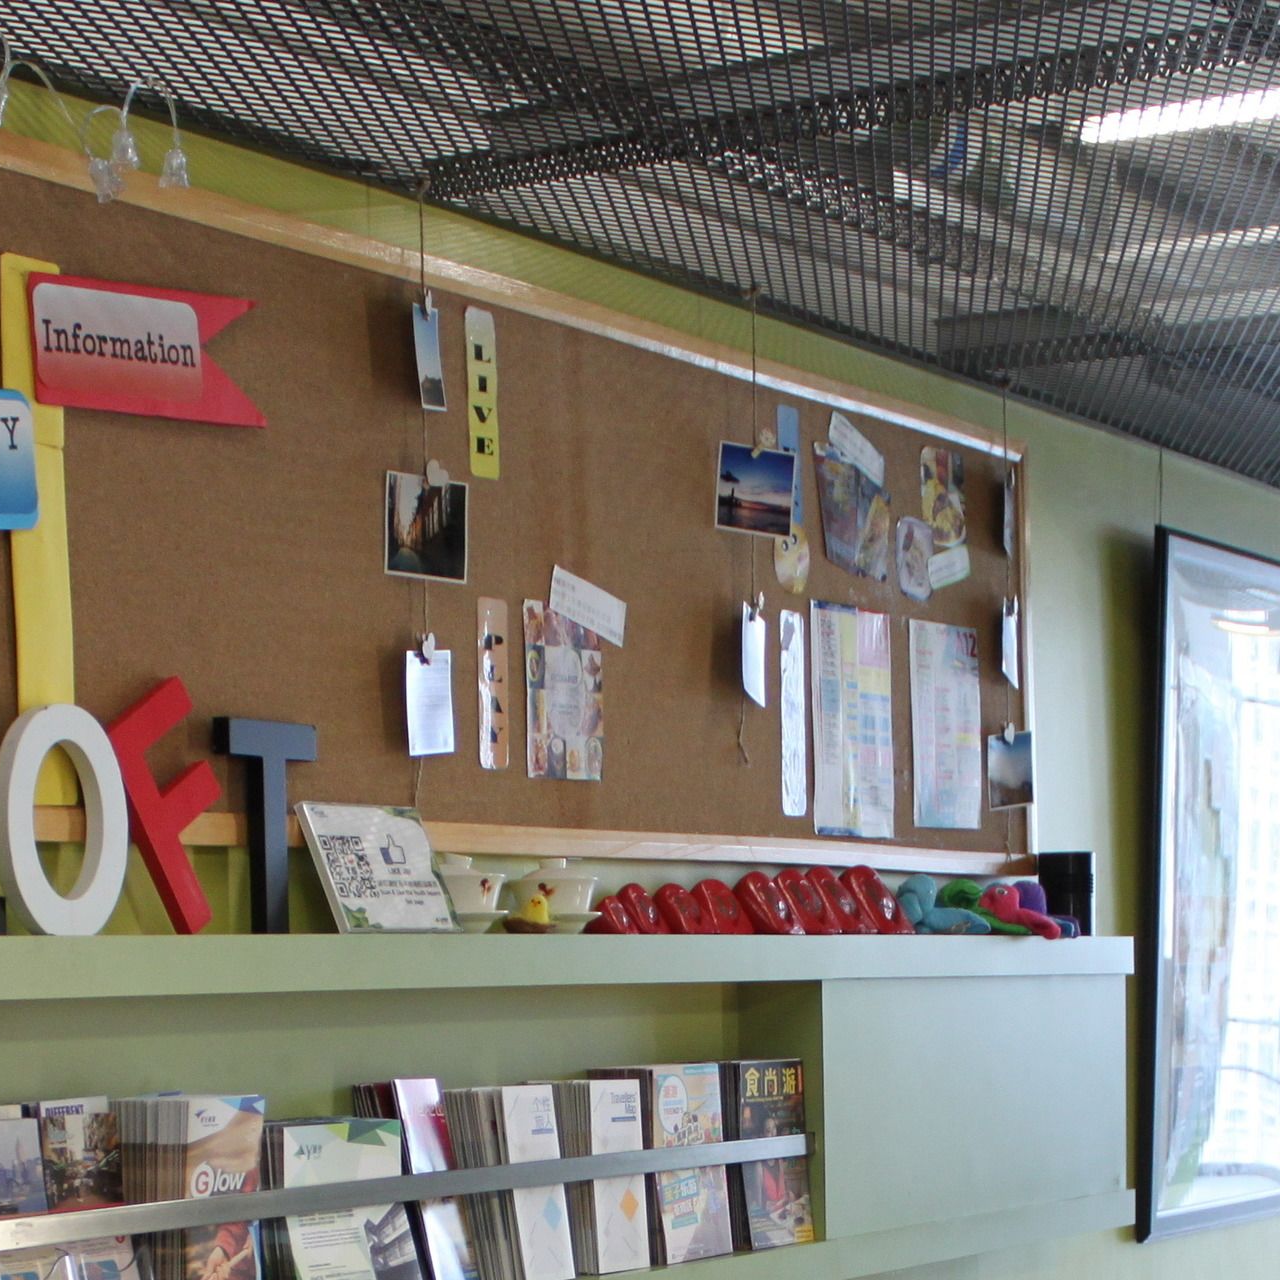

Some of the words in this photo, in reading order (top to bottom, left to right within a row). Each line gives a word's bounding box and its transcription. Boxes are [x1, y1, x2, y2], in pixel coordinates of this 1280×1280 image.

[41, 319, 196, 368] Information
[473, 342, 494, 457] LIVE
[0, 416, 20, 450] Y
[193, 1166, 247, 1197] Glow
